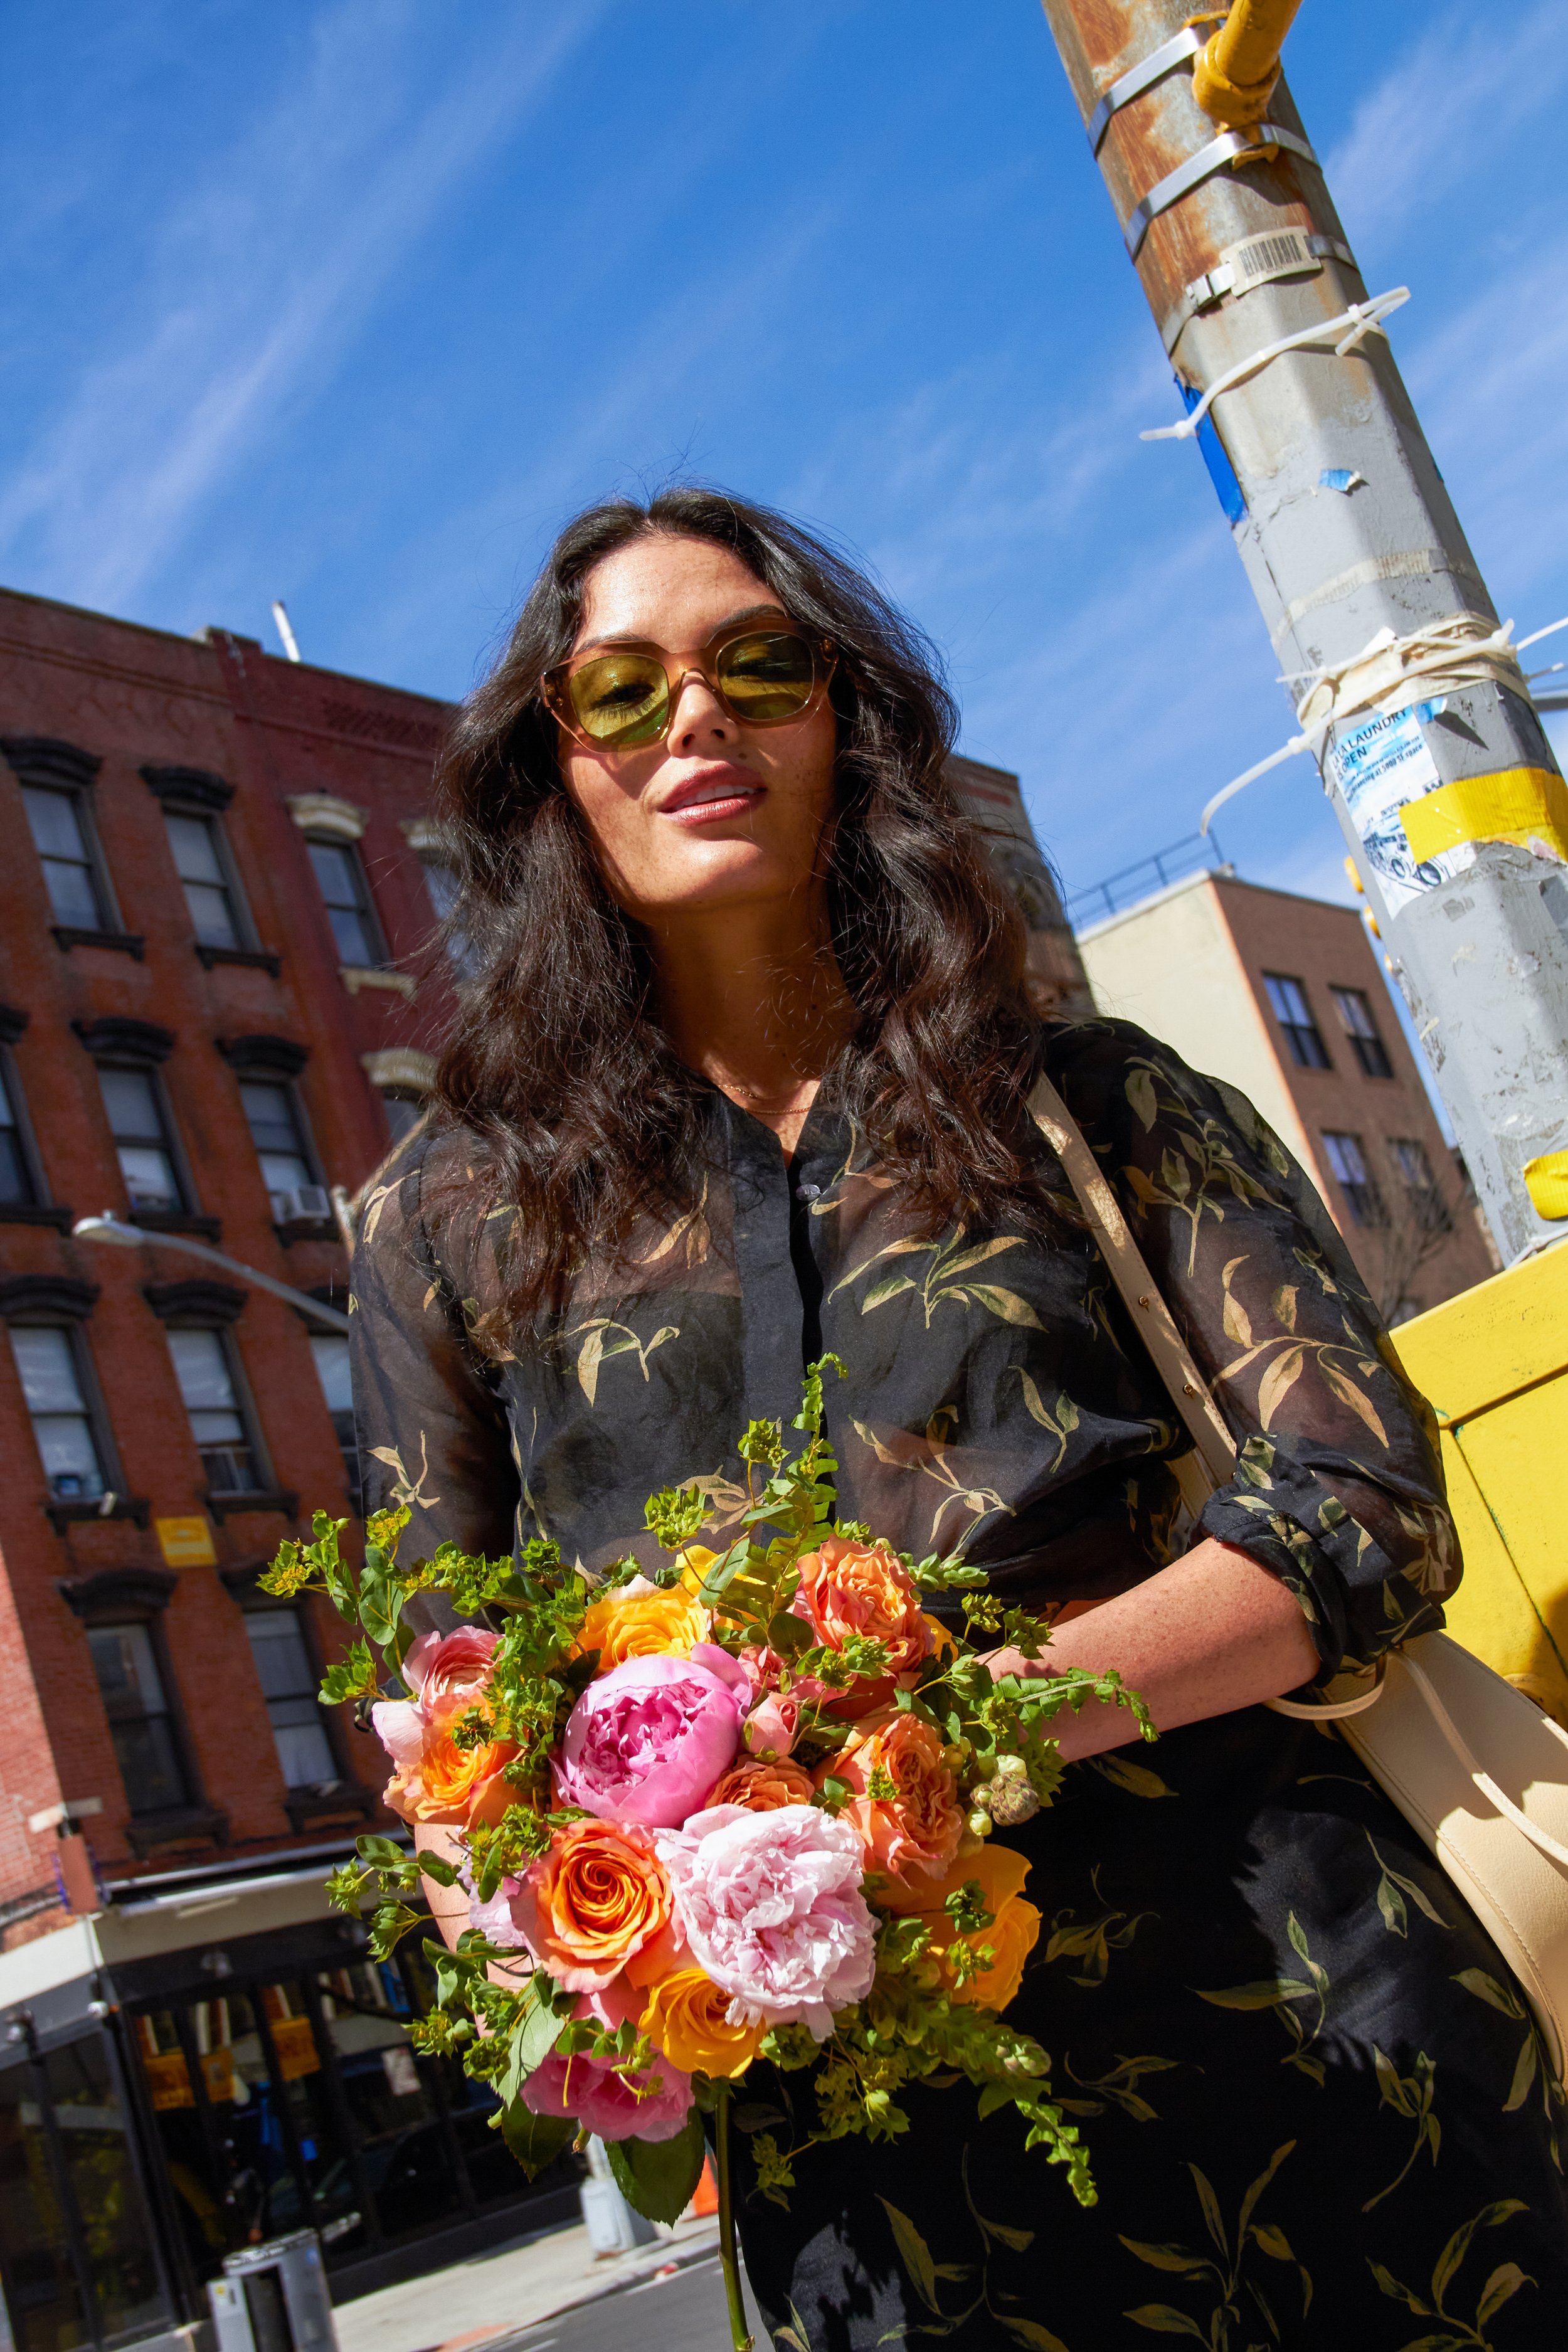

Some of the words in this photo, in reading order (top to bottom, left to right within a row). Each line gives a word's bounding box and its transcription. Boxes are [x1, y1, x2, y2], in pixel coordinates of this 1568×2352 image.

[1338, 745, 1348, 759] LA
[1348, 708, 1406, 748] LAUNDRY
[1342, 746, 1367, 773] OPEN
[1405, 744, 1422, 757] space
